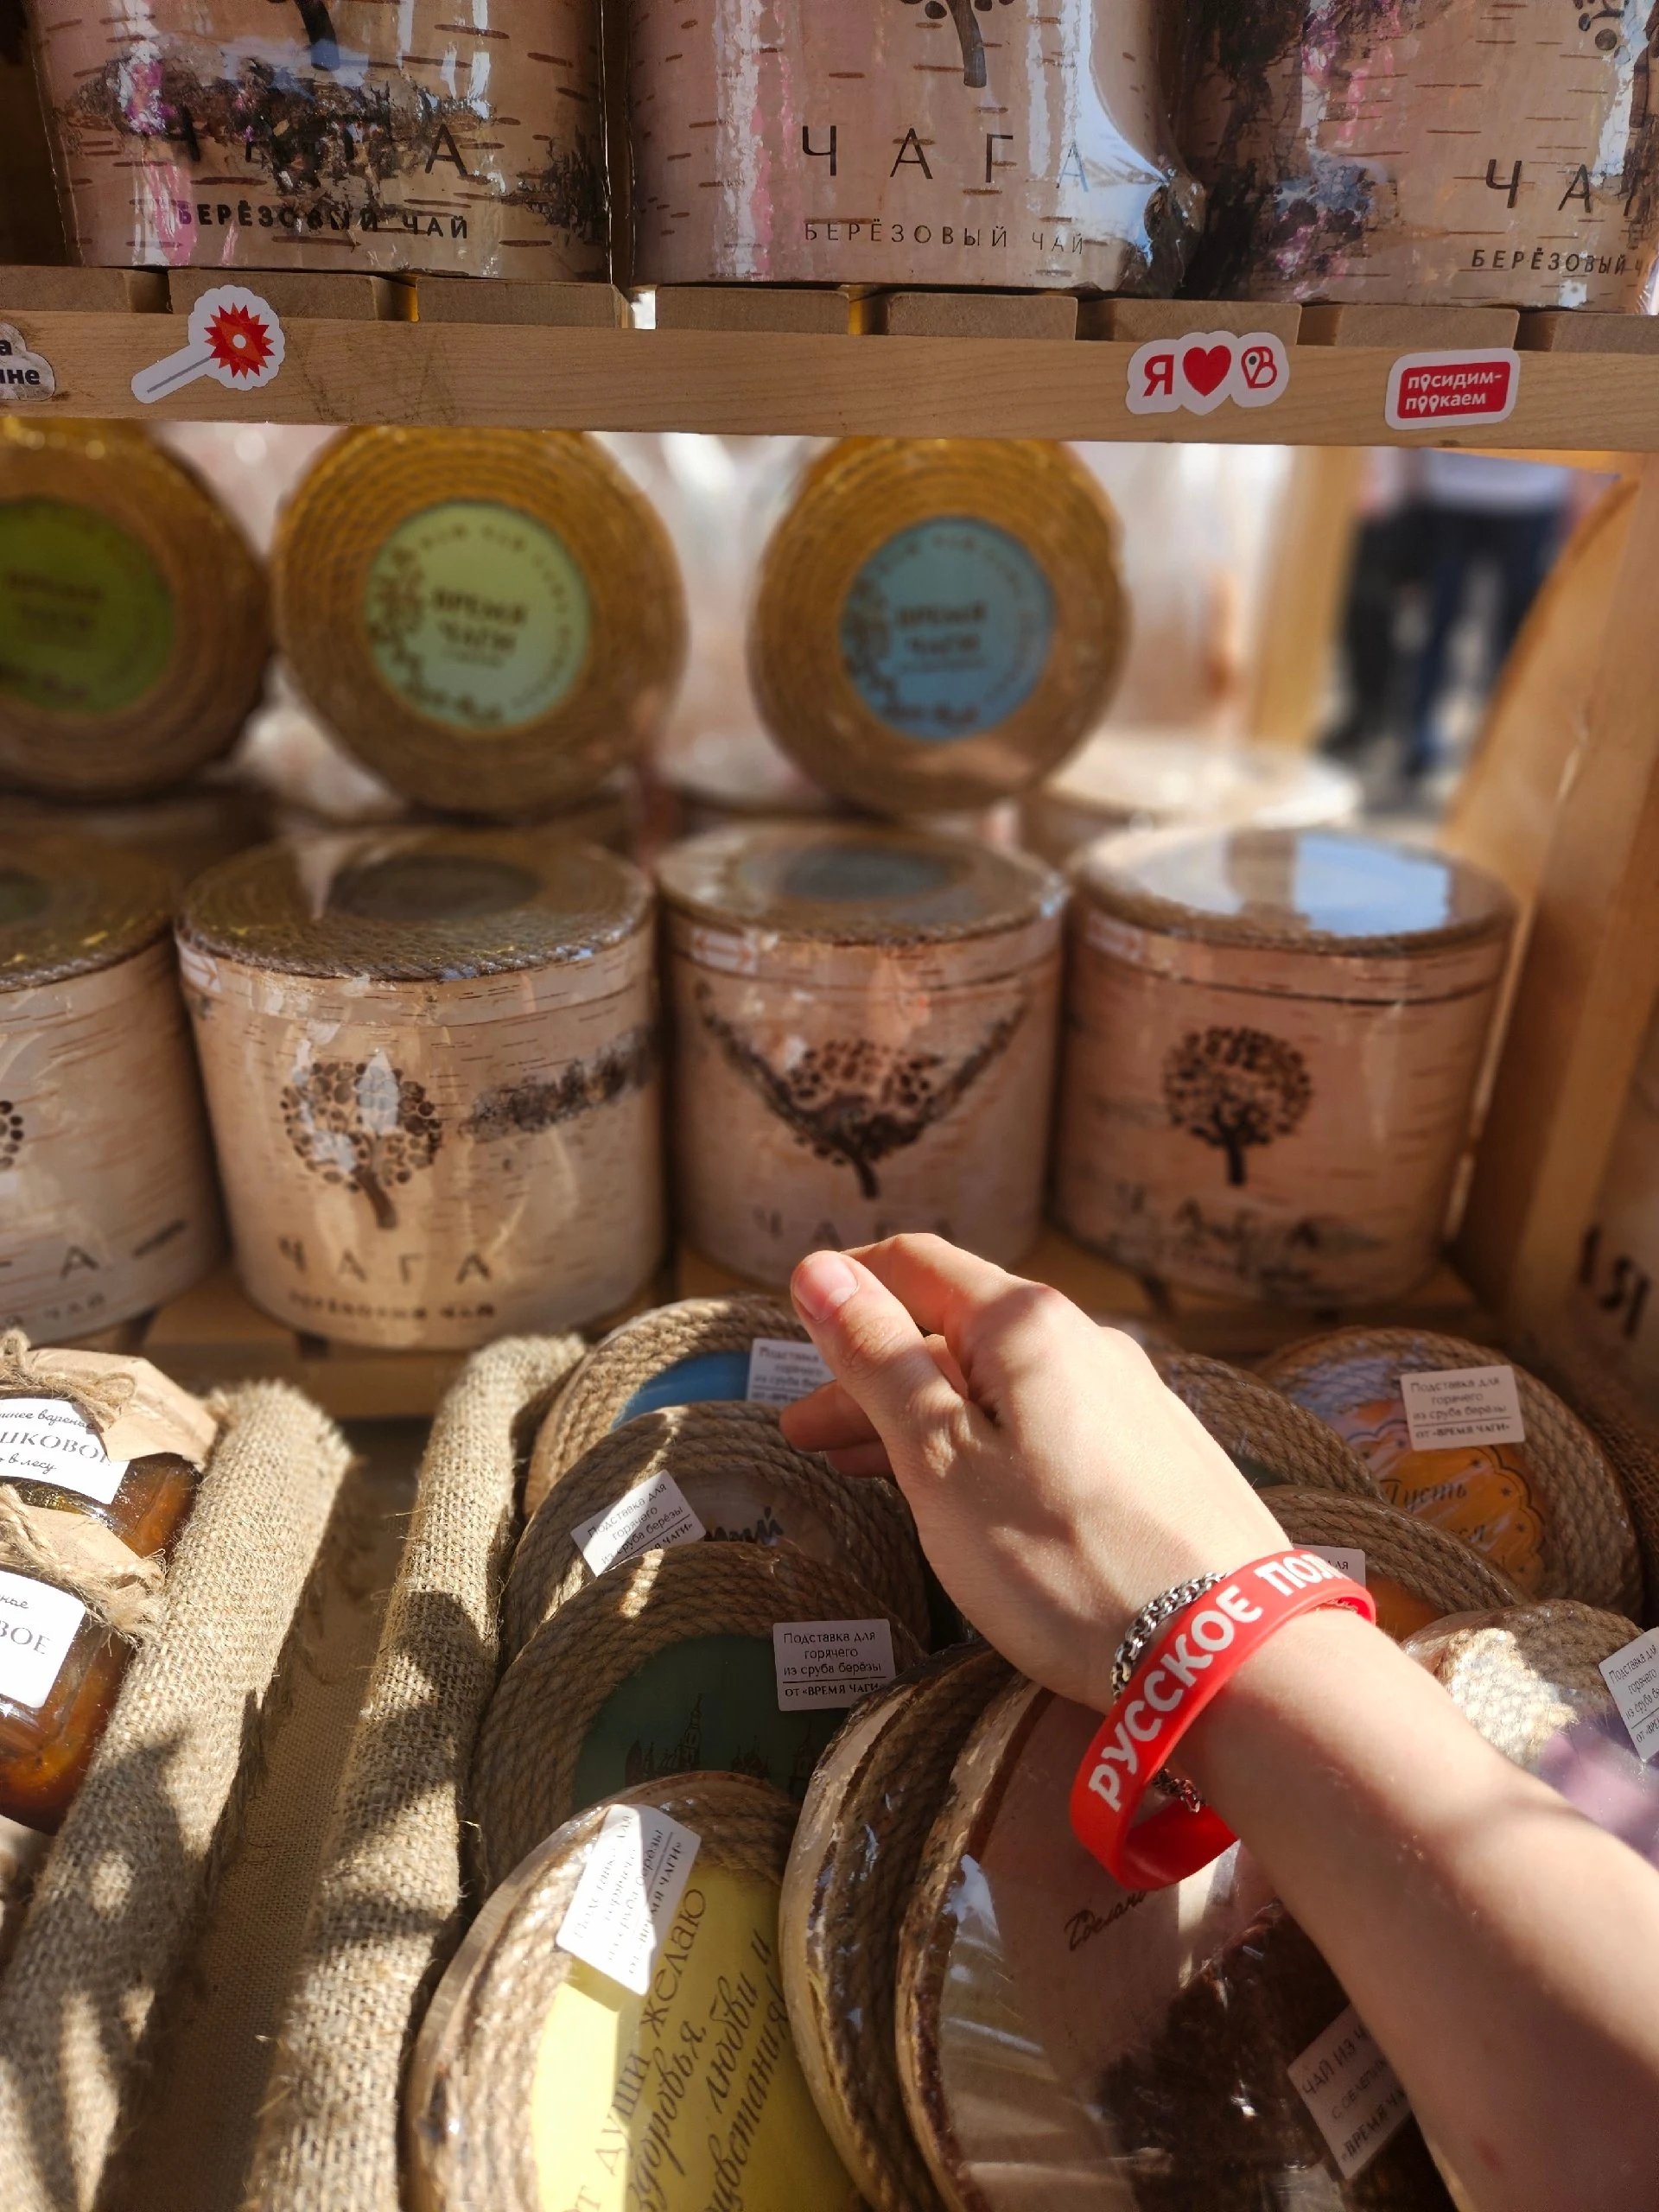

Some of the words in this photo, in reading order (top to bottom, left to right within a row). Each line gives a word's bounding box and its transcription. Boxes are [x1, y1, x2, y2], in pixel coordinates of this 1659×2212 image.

[803, 125, 1089, 193] ЧАГА
[403, 215, 468, 239] ЧАЙ
[804, 218, 1007, 248] БЕРЁЗОВЫЙ
[1033, 232, 1084, 254] ЧАЙ
[1471, 246, 1626, 276] БЕРЁЗОВЫЙ
[1142, 353, 1175, 397] Я
[1407, 372, 1503, 392] посидим-
[1410, 1379, 1476, 1393] Подставка
[1478, 1376, 1499, 1388] для
[1431, 1392, 1484, 1406] горячего
[1429, 1407, 1462, 1421] сруба
[587, 1498, 645, 1538] Подставка
[647, 1483, 667, 1503] для
[612, 1506, 658, 1541] горячего
[1328, 1560, 1349, 1570] ля
[783, 1632, 850, 1645] Подставка
[854, 1631, 875, 1643] для
[804, 1647, 859, 1662] горячего
[783, 1666, 798, 1676] из
[800, 1662, 835, 1678] сруба
[837, 1661, 881, 1676] берёзы
[1608, 1652, 1647, 1684] Подставка
[802, 1683, 847, 1697] «ВРЕМЯ
[1628, 1669, 1658, 1696] горячего
[1087, 1585, 1264, 1813] РУССКОЕ
